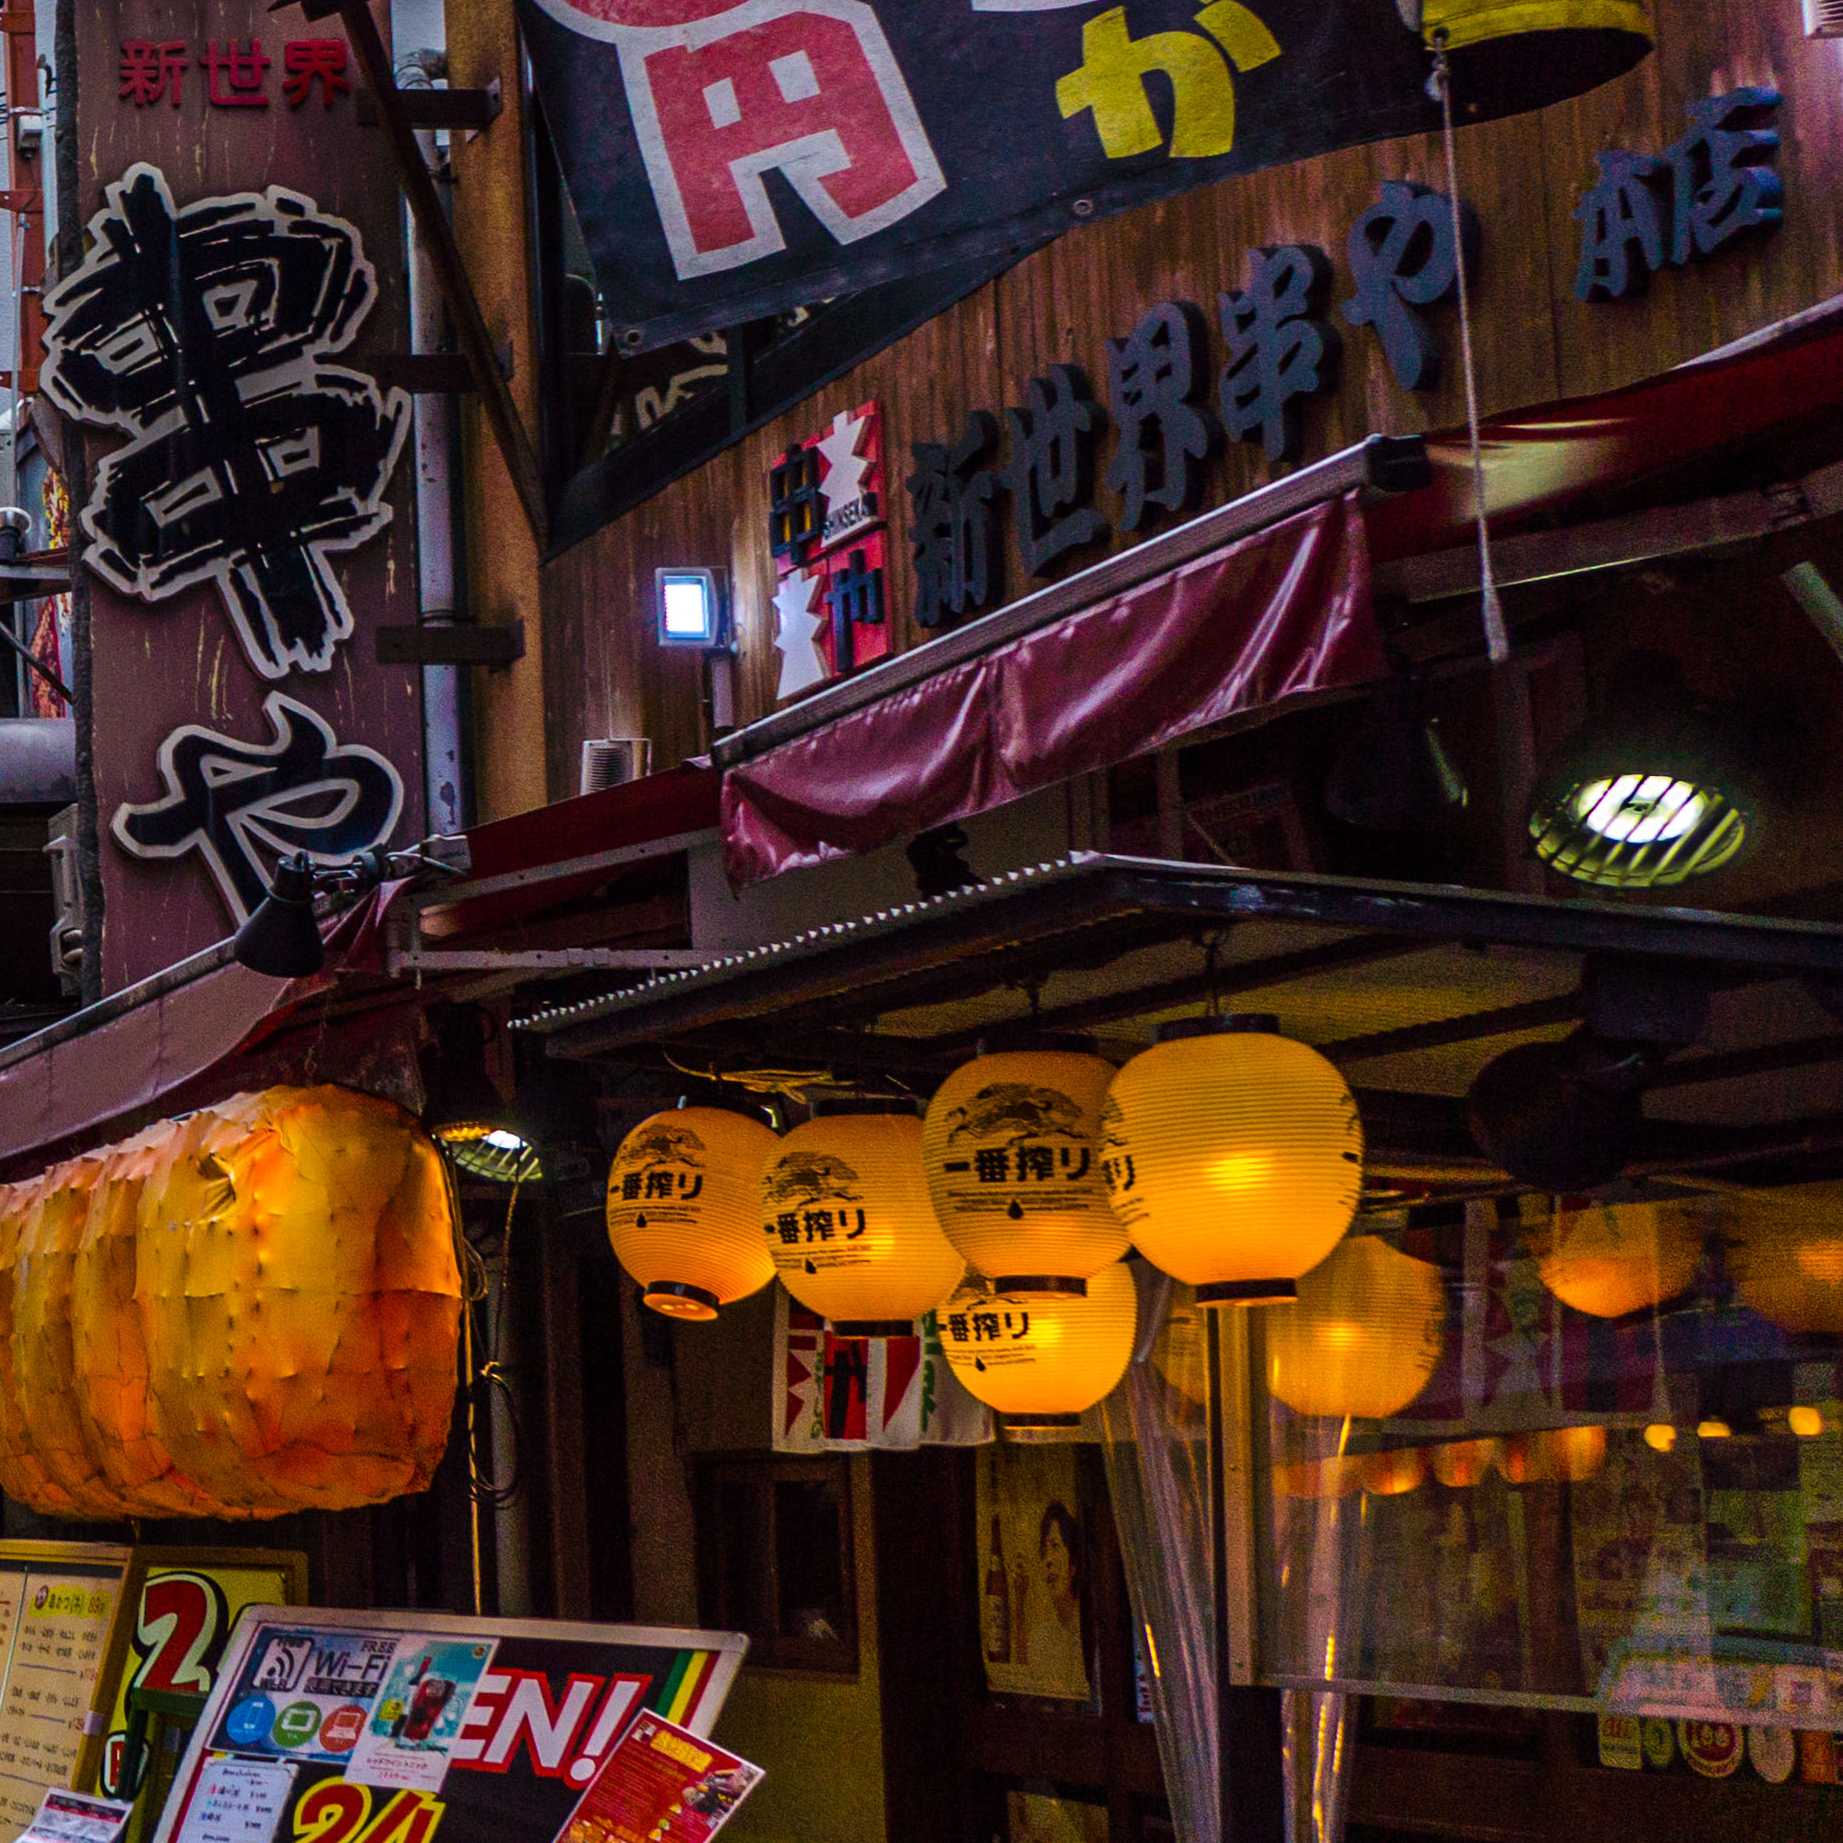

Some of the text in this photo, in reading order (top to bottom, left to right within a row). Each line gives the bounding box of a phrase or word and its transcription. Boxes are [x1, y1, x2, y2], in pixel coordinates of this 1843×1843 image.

[118, 38, 353, 110] 新世界
[907, 86, 1785, 631] 新世界串や 本店
[40, 161, 412, 936] 串や
[944, 1146, 1090, 1183] 一番搾り
[609, 1171, 704, 1201] 一番搾り
[764, 1208, 865, 1244] 一番搾り
[938, 1311, 1029, 1343] 一番搾り
[314, 1651, 391, 1681] Wi-Fi
[450, 1667, 654, 1790] EN!
